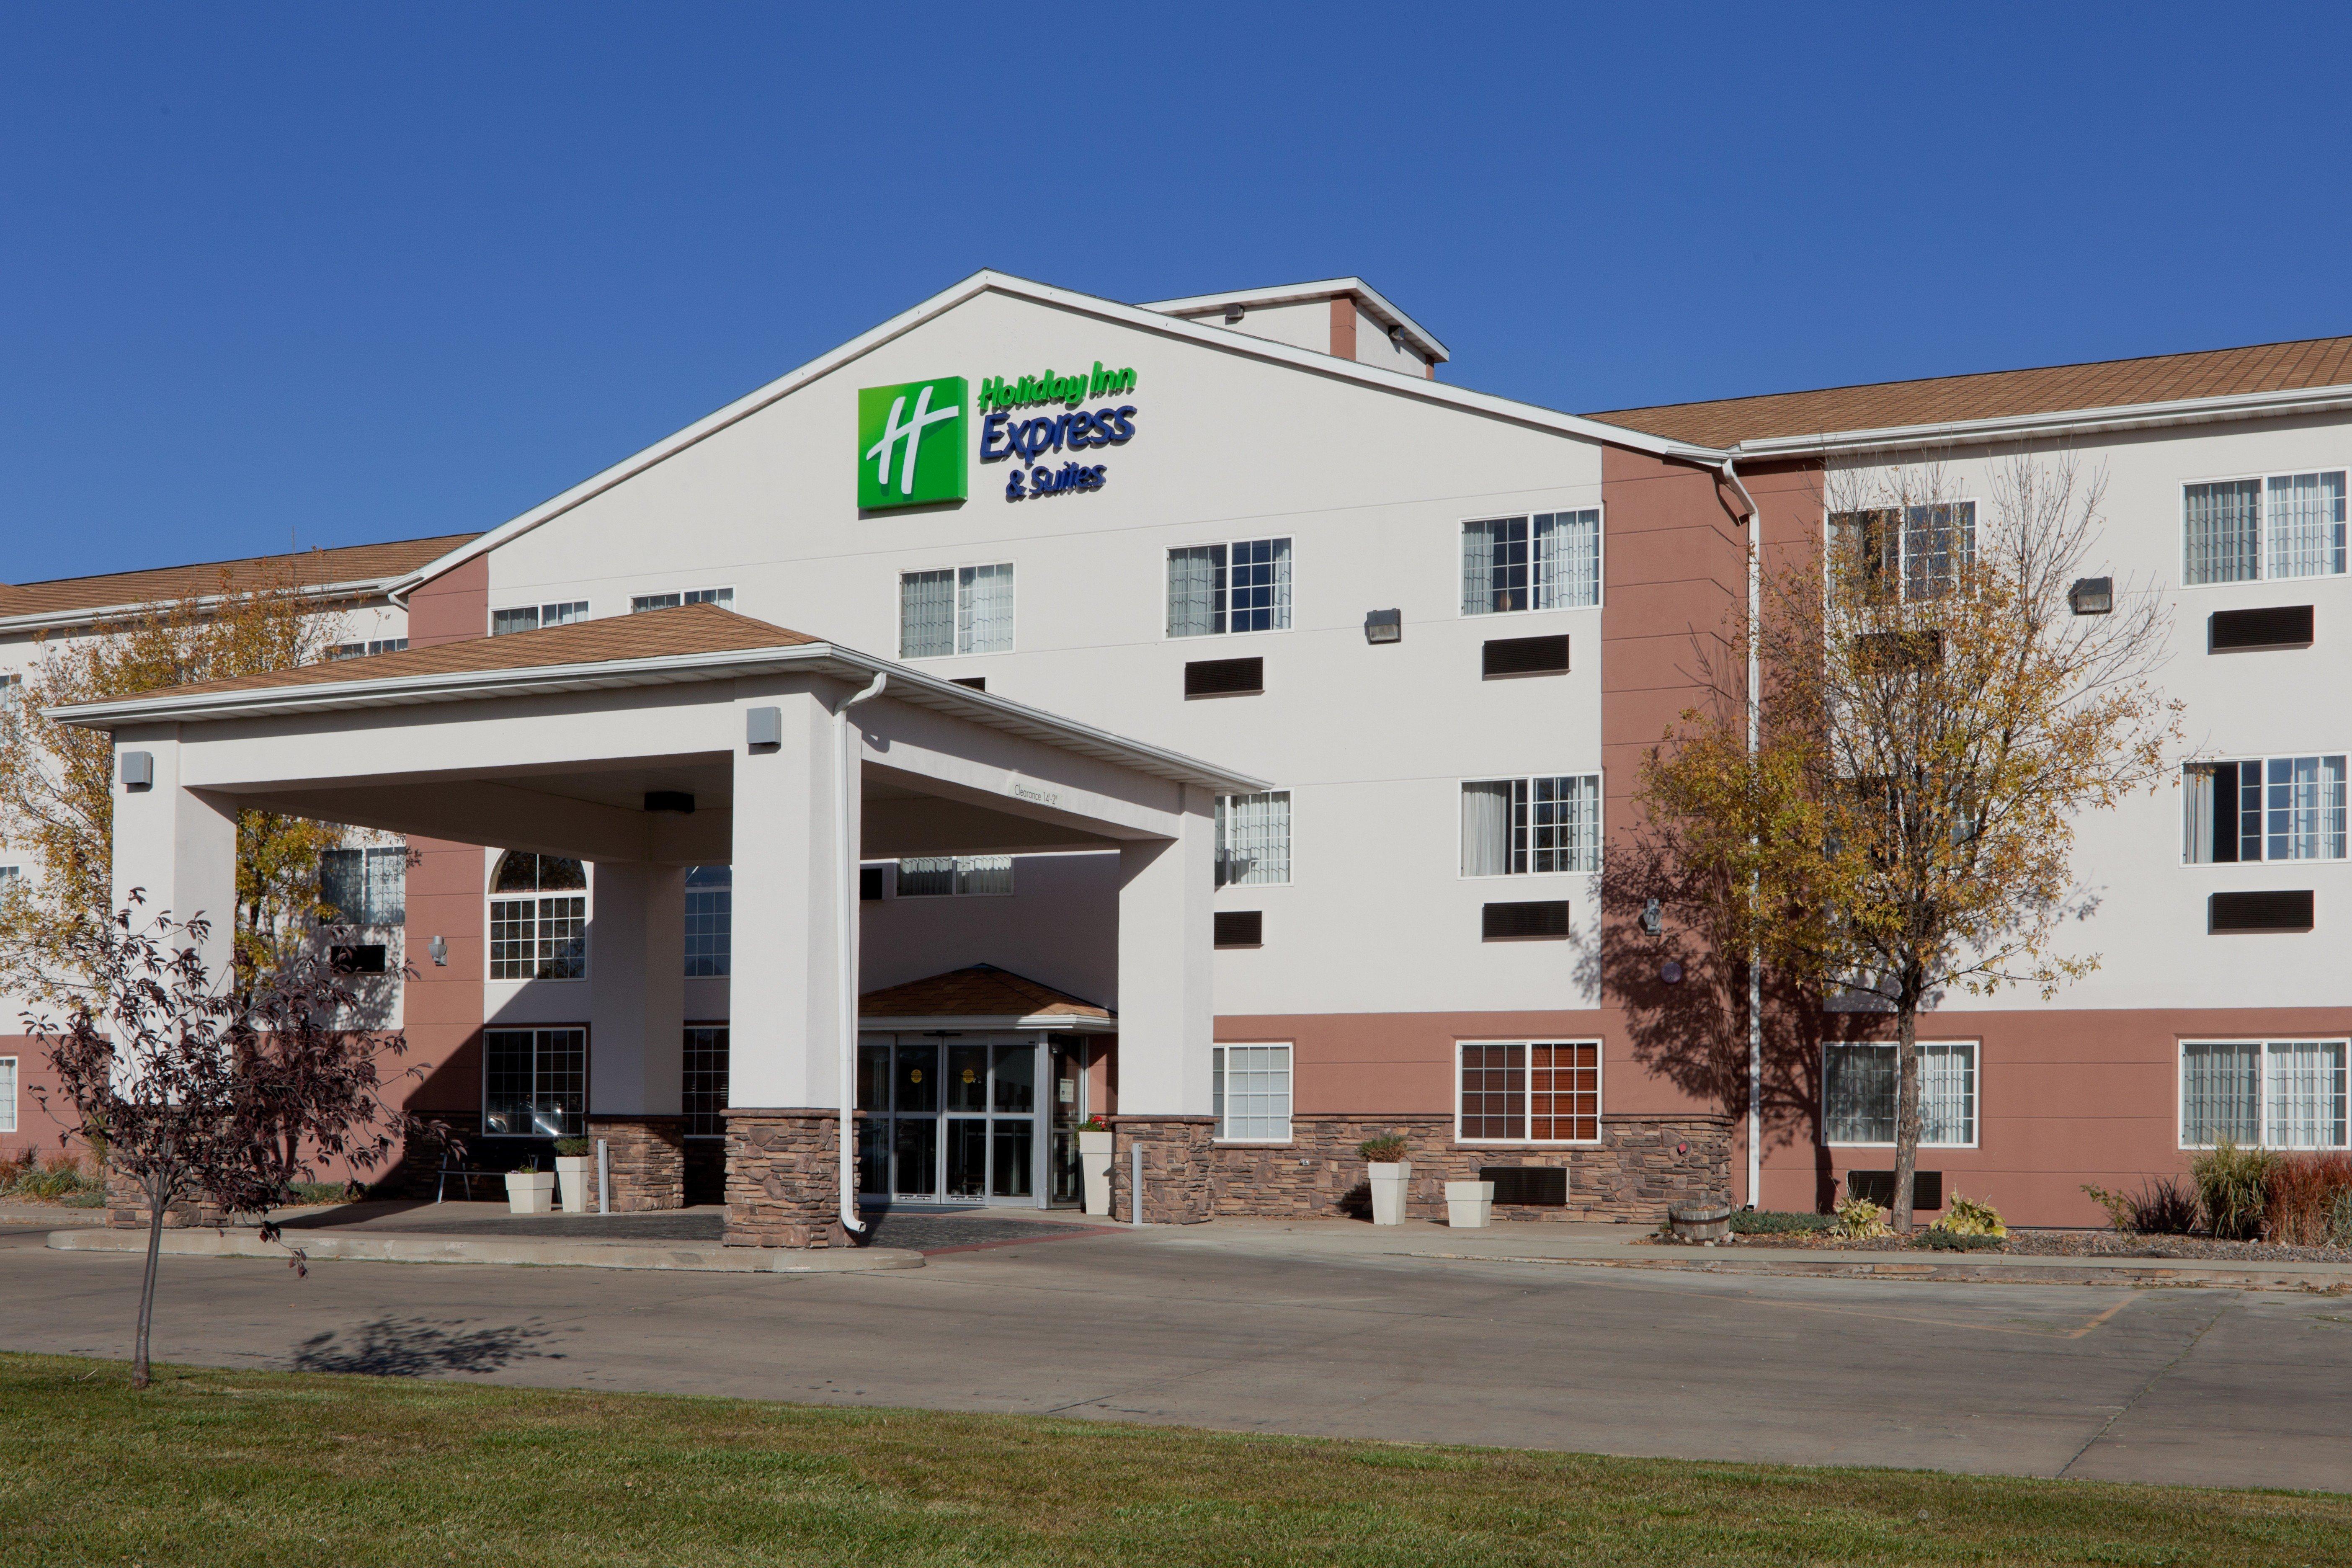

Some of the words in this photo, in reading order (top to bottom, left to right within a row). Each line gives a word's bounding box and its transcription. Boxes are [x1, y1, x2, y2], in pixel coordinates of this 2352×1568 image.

[978, 369, 1088, 410] Holiday
[1089, 361, 1137, 393] Inn
[866, 386, 959, 495] H
[980, 405, 1137, 465] Express
[1006, 470, 1026, 497] &
[1029, 461, 1107, 495] Suites
[1014, 784, 1041, 800] Clearance
